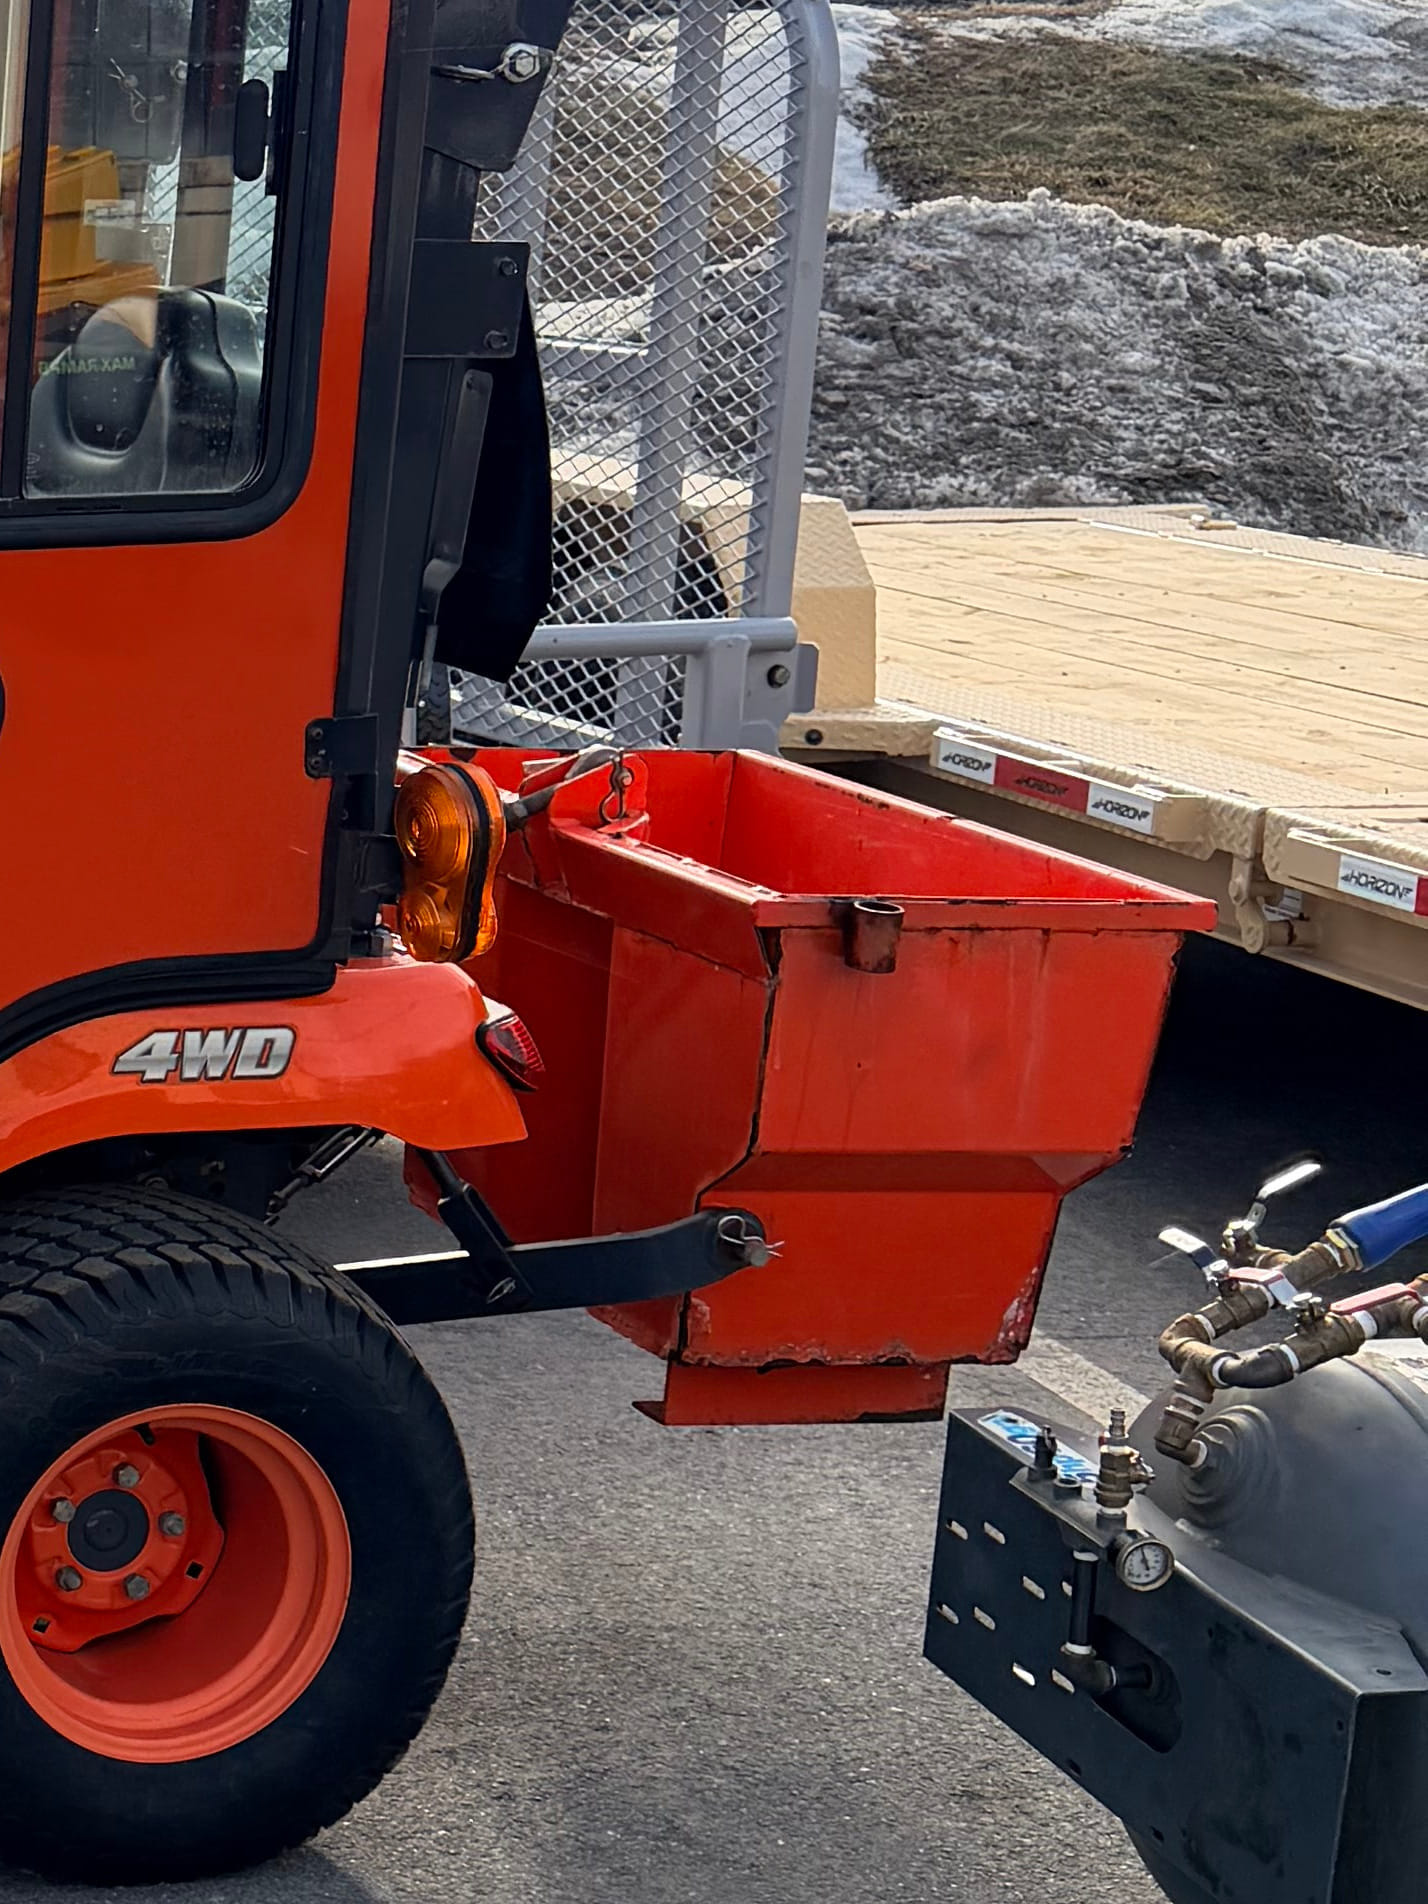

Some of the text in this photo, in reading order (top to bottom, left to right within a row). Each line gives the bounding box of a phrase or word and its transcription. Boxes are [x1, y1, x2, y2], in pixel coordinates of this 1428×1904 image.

[1098, 797, 1144, 822] HORIZON
[1348, 869, 1405, 900] HORIZON
[113, 1024, 297, 1083] 4WD
